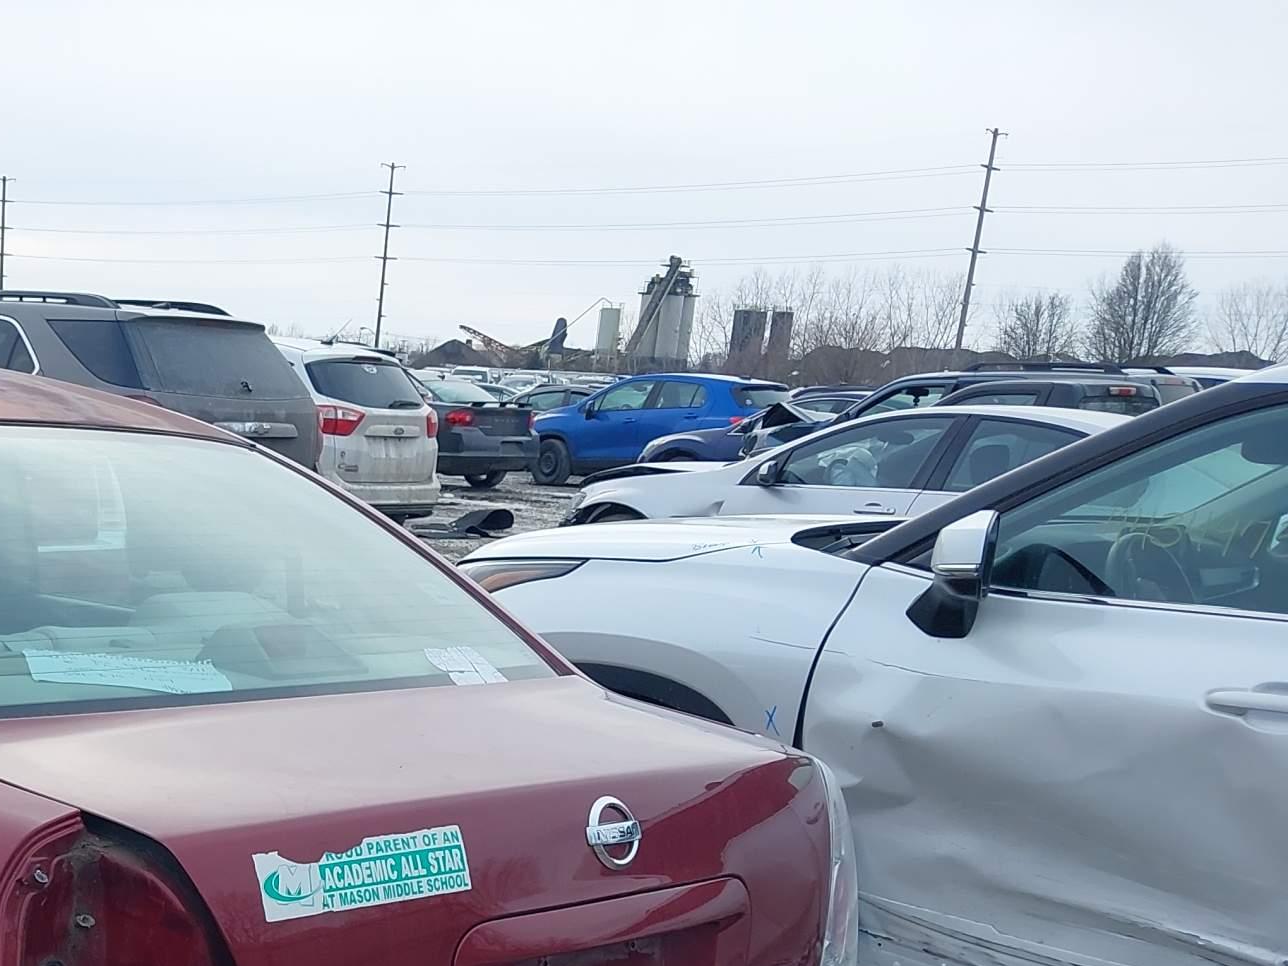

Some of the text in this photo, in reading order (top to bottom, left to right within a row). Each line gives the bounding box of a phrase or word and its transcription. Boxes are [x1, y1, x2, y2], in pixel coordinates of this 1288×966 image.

[325, 830, 461, 861] ROUD PARENT OF AN
[324, 850, 464, 891] ACADEMIC ALL STAR
[321, 873, 469, 910] AT MASON MIDDLE SCHOOL
